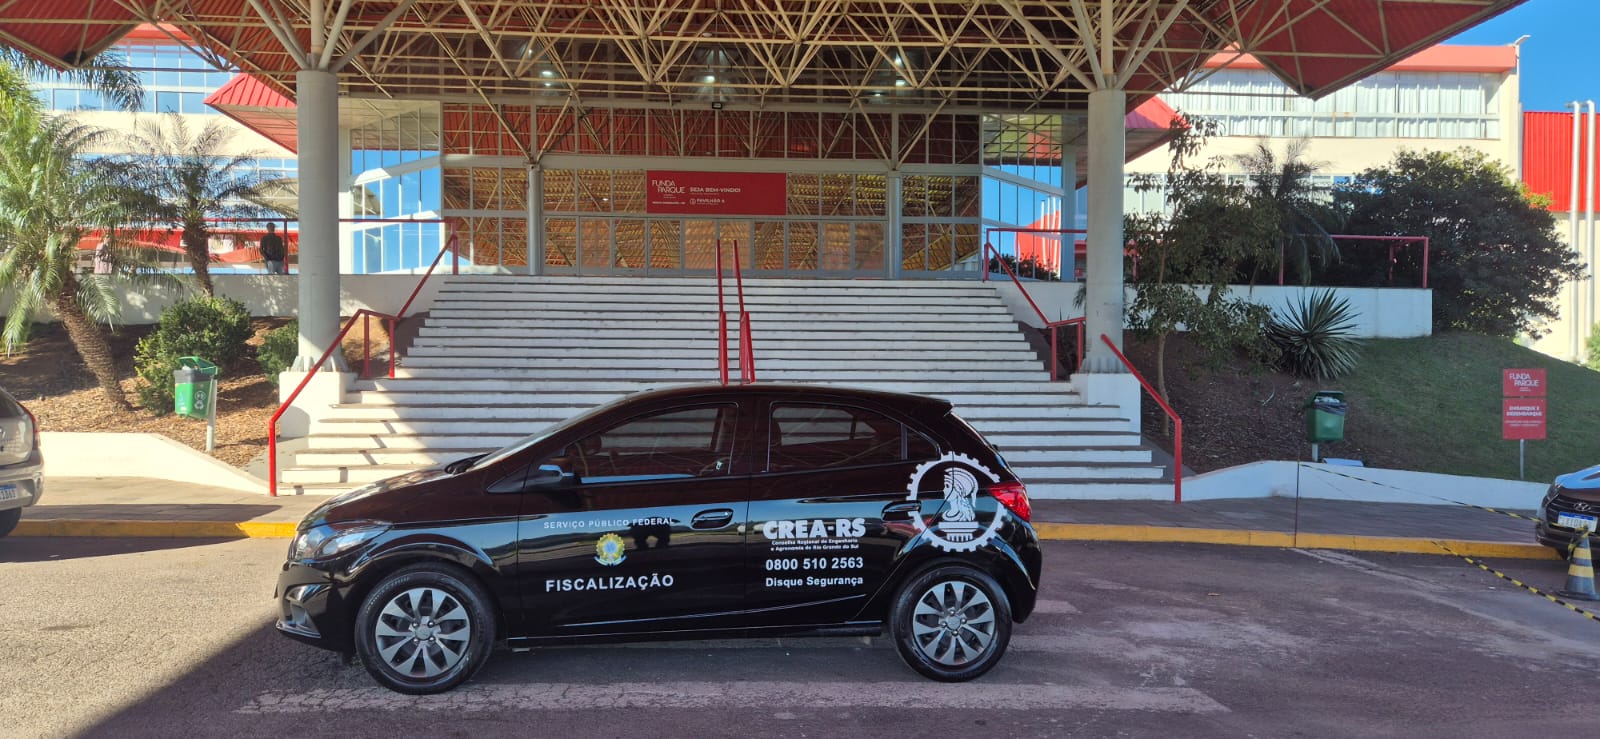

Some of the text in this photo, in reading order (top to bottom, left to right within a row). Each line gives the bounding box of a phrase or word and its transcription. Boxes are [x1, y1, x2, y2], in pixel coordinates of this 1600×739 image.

[1514, 379, 1540, 387] PARQUE
[543, 517, 675, 529] SERVIÇO PÚBLICO FEDERAL
[762, 518, 866, 539] CREA-RS
[765, 556, 864, 571] 0800 510 2563
[545, 573, 674, 592] FISCALIZAÇÃO
[765, 576, 864, 589] Disque Segurança
